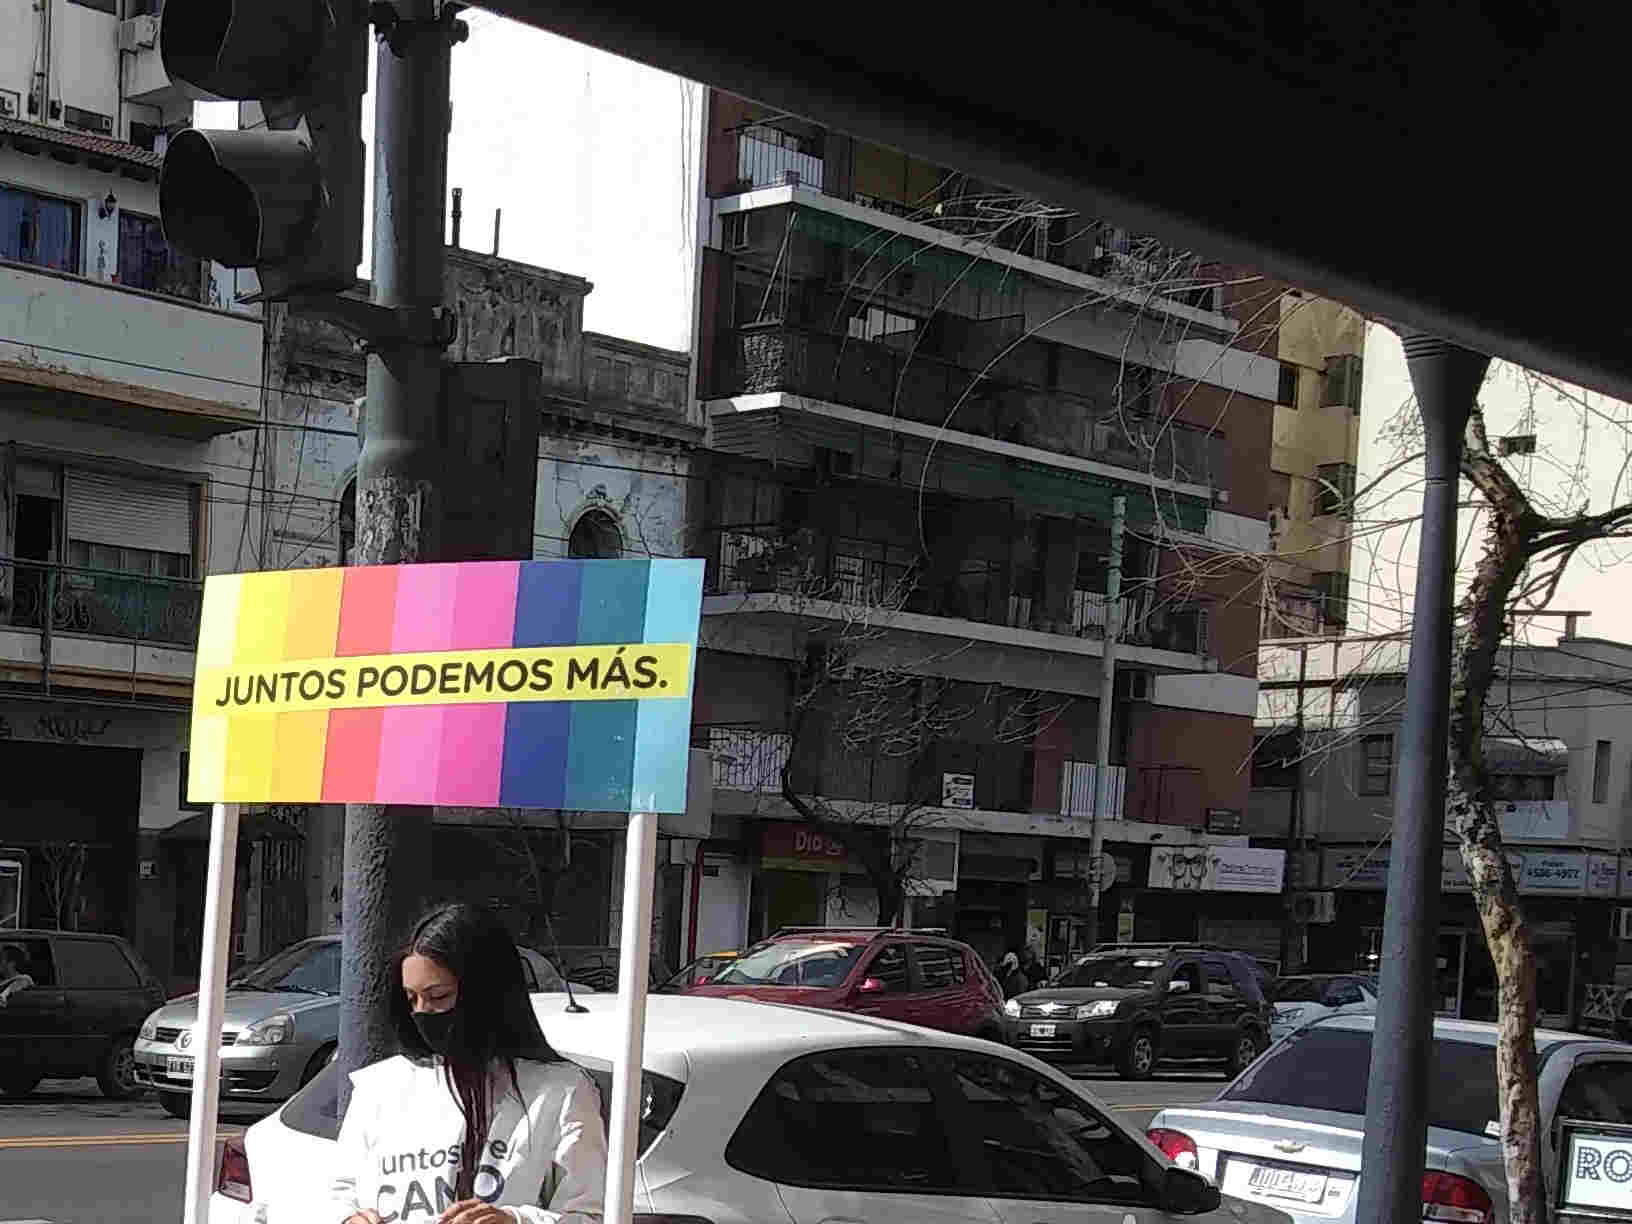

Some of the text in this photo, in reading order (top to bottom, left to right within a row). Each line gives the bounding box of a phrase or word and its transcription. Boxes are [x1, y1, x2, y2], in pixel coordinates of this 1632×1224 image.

[215, 647, 668, 707] JUNTOS PODEMOS MÁS.
